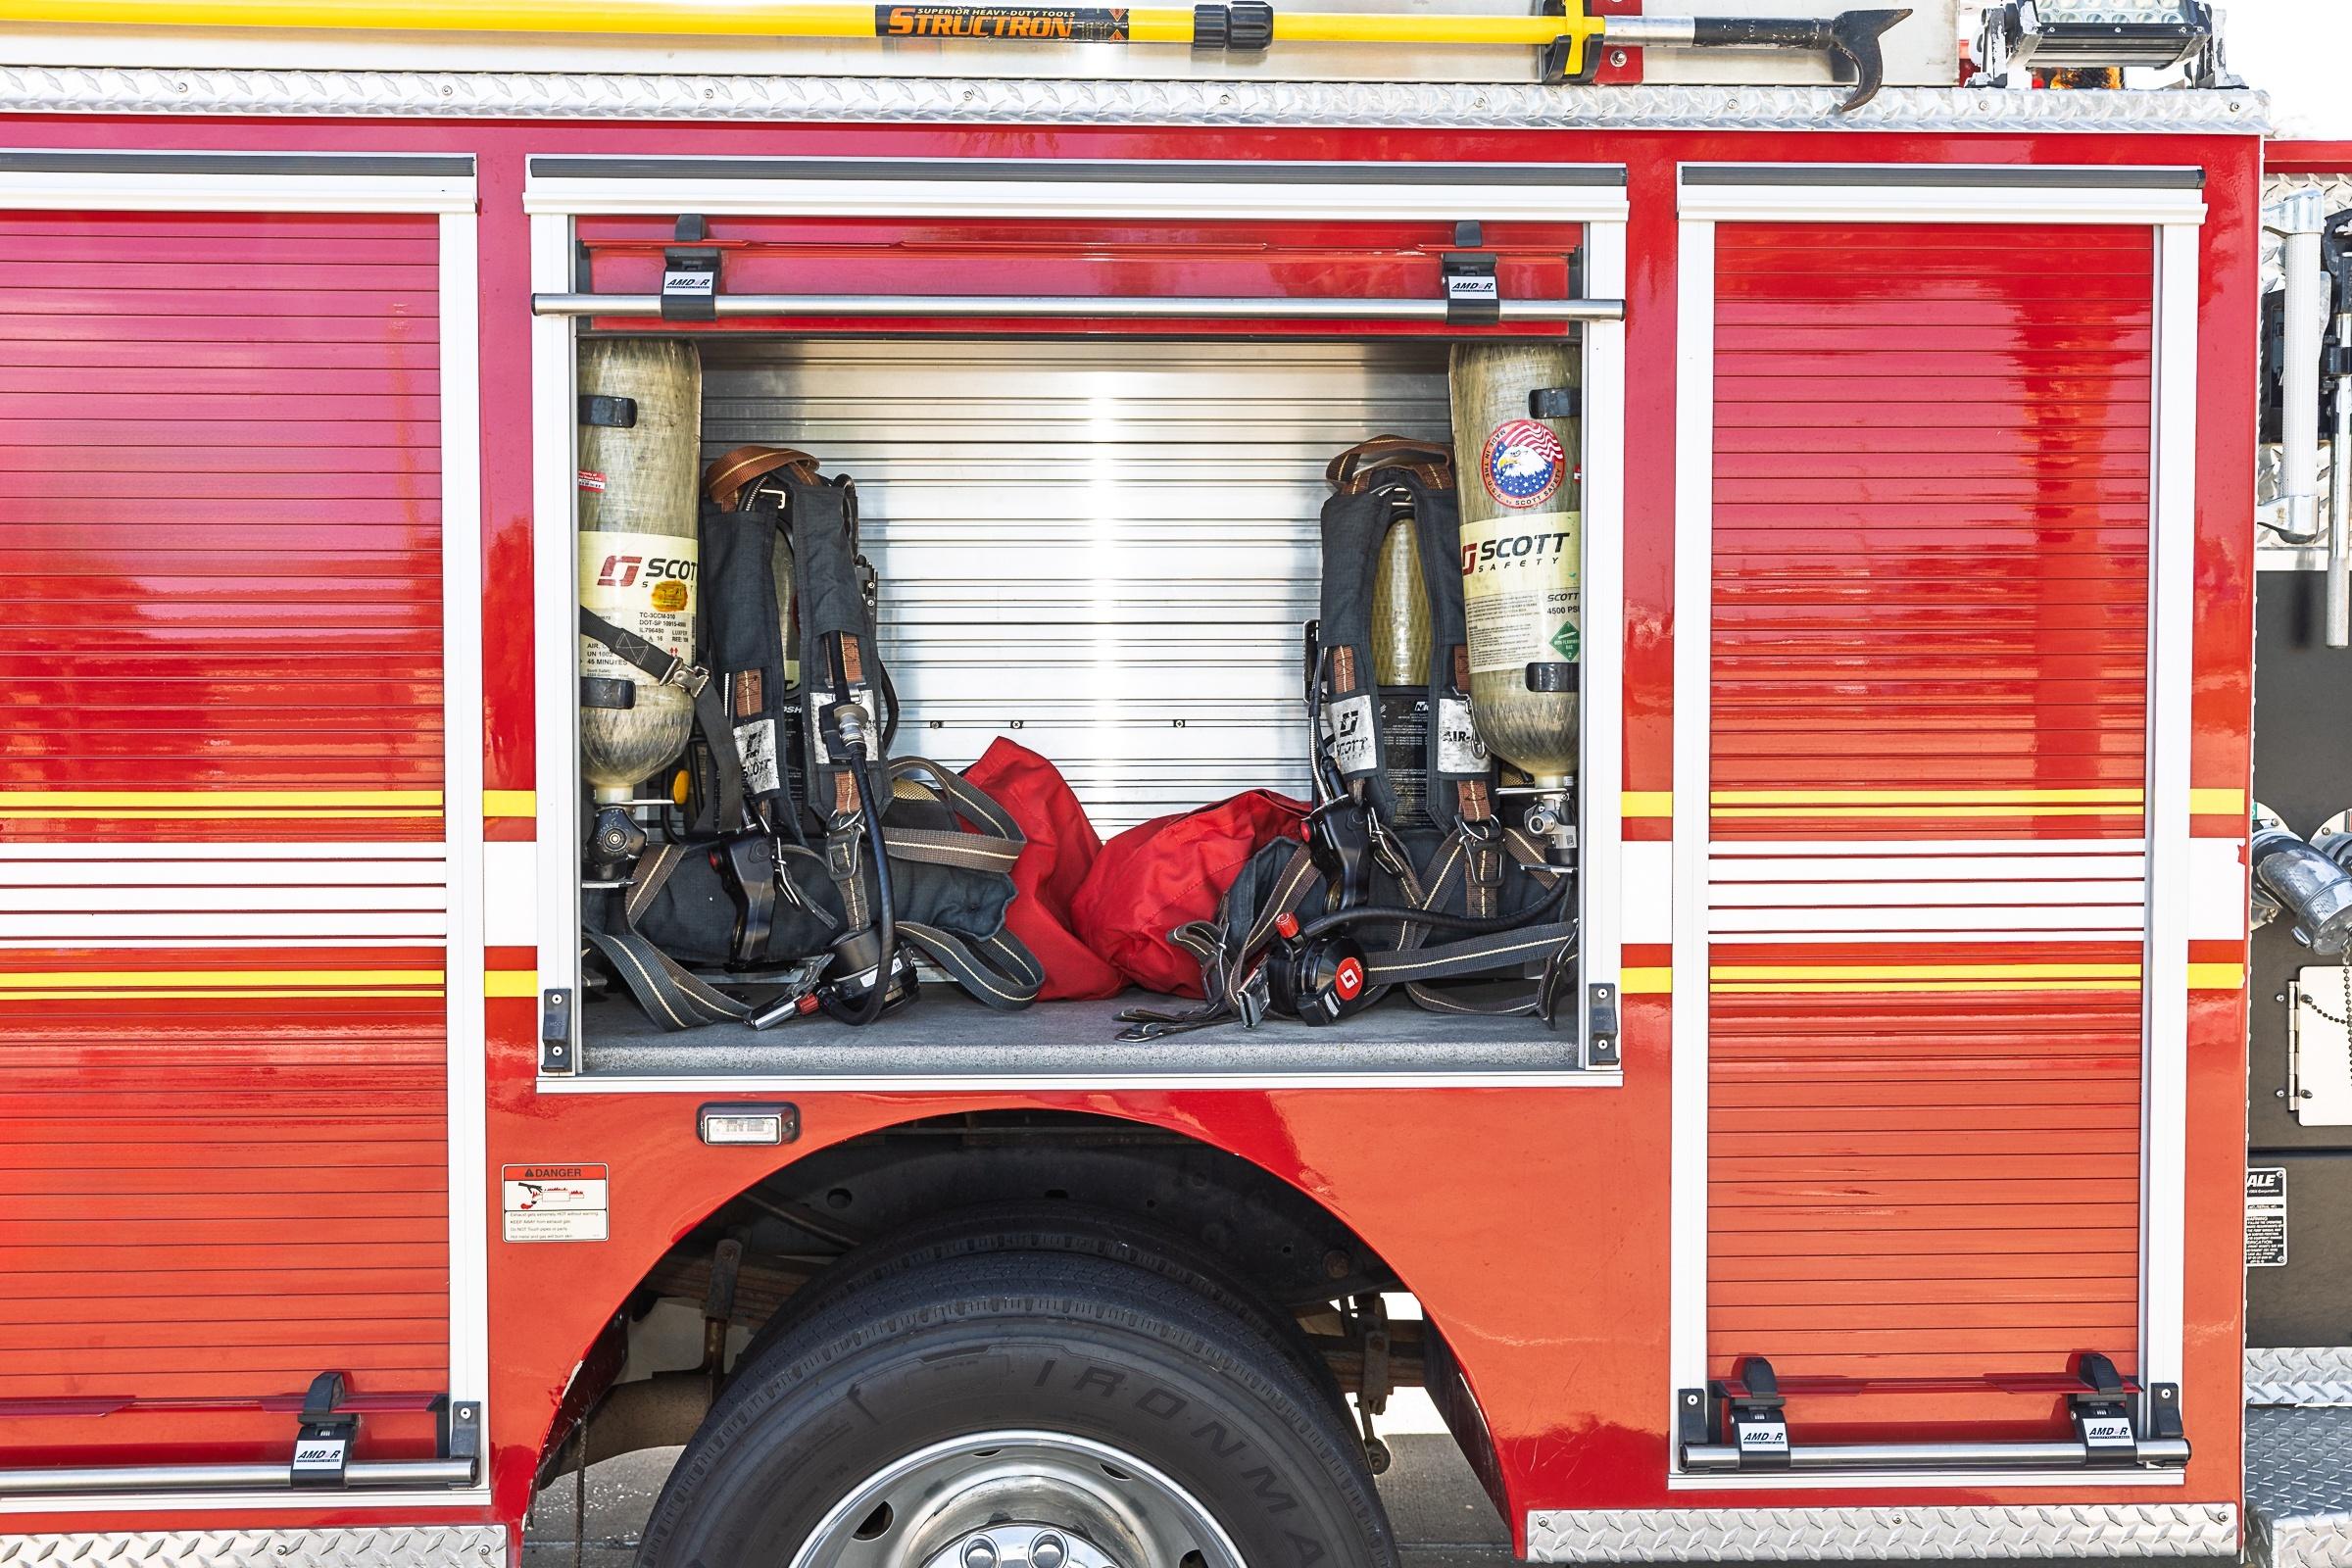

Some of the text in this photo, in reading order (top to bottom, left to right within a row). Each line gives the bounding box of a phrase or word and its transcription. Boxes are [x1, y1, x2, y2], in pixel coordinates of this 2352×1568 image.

[888, 7, 1074, 37] STRUCTRON
[1491, 428, 1506, 448] MADE
[1484, 450, 1491, 459] IN
[1544, 468, 1562, 497] SAFETY
[1515, 495, 1542, 506] SCOTT
[1480, 532, 1570, 562] SCOTT
[645, 558, 698, 581] SCOT
[1478, 557, 1559, 573] SAFETY
[1547, 592, 1580, 602] SCOTT
[1442, 730, 1470, 742] AIR-
[535, 1168, 582, 1177] DANGER
[2247, 1174, 2277, 1187] ALE
[1743, 1432, 1784, 1441] AMDR
[2088, 1427, 2129, 1436] AMDR
[298, 1449, 341, 1458] AMDR
[1034, 1359, 1326, 1568] IRONMA
